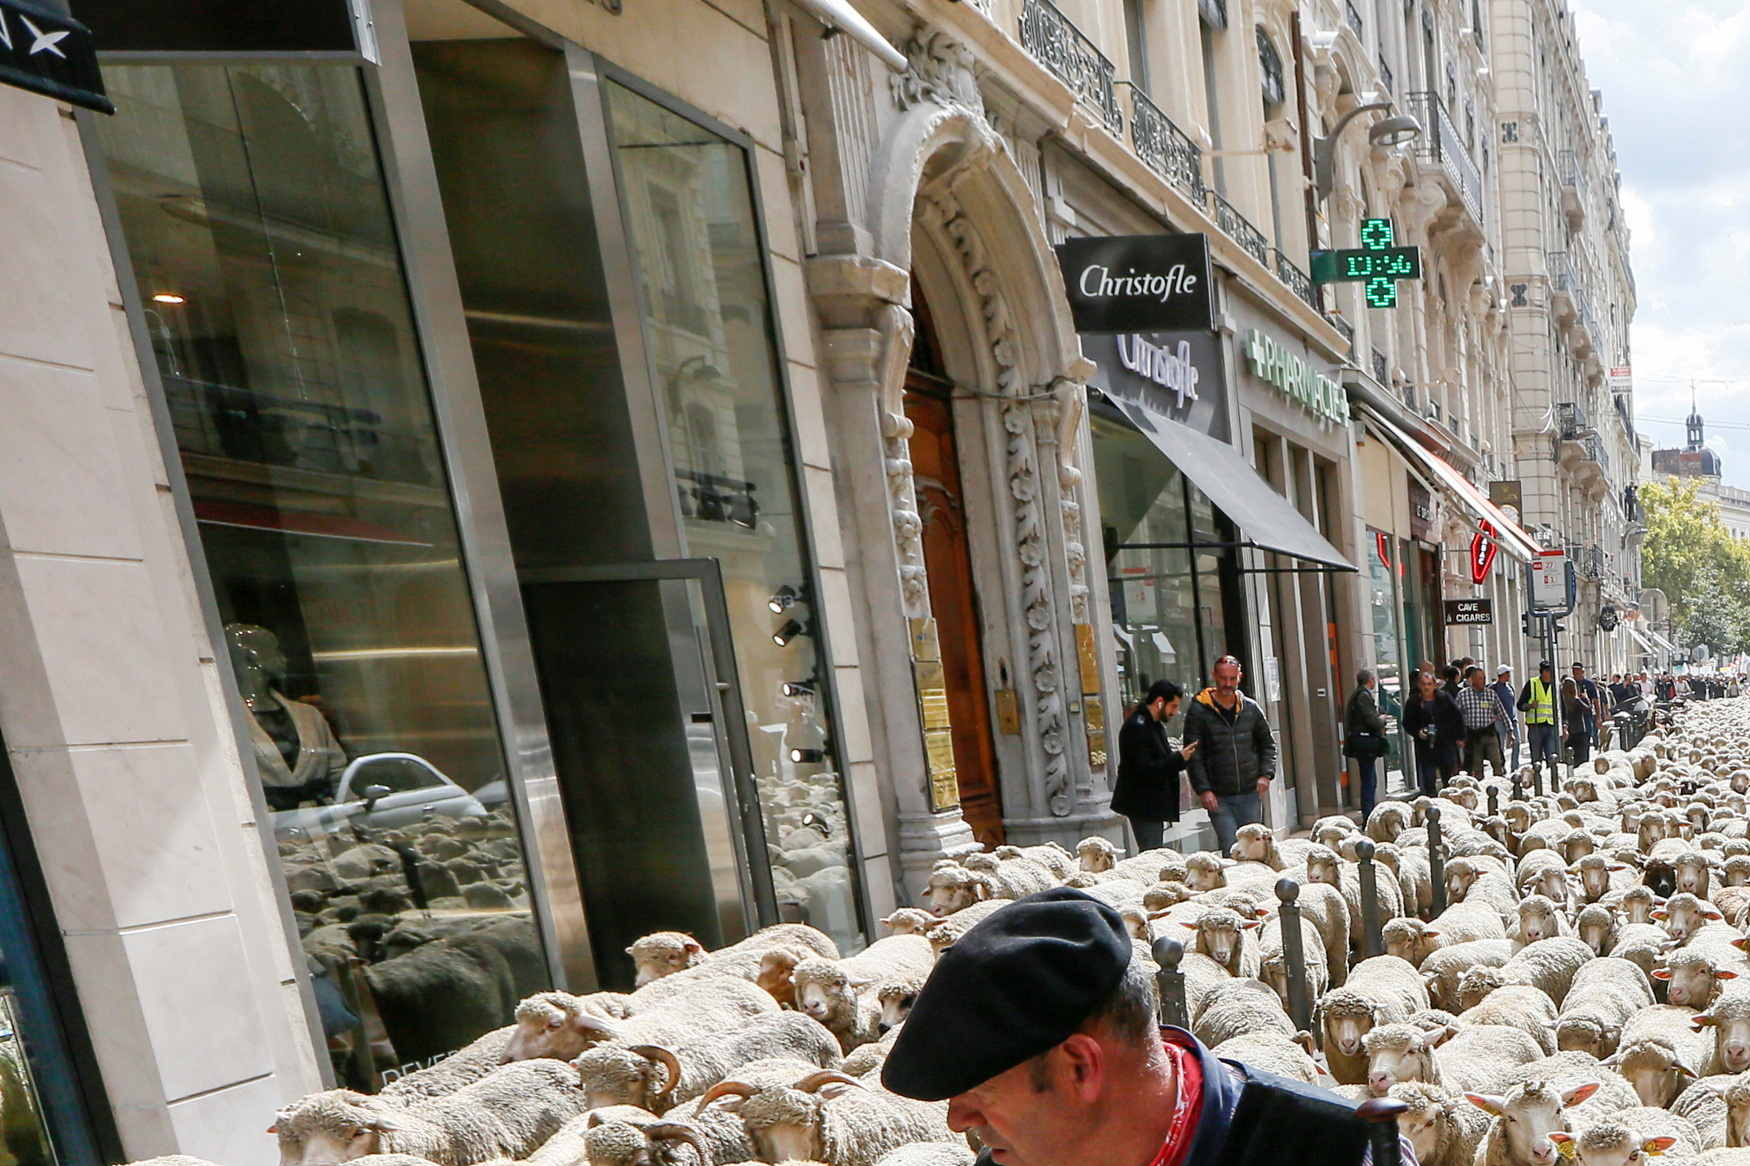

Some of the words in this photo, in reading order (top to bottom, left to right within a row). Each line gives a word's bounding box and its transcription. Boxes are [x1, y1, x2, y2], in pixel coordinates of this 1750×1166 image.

[1079, 264, 1198, 303] Christofle
[1263, 335, 1342, 424] PHARMACIE
[1455, 613, 1491, 622] CIGARES
[1457, 603, 1479, 612] CAVE
